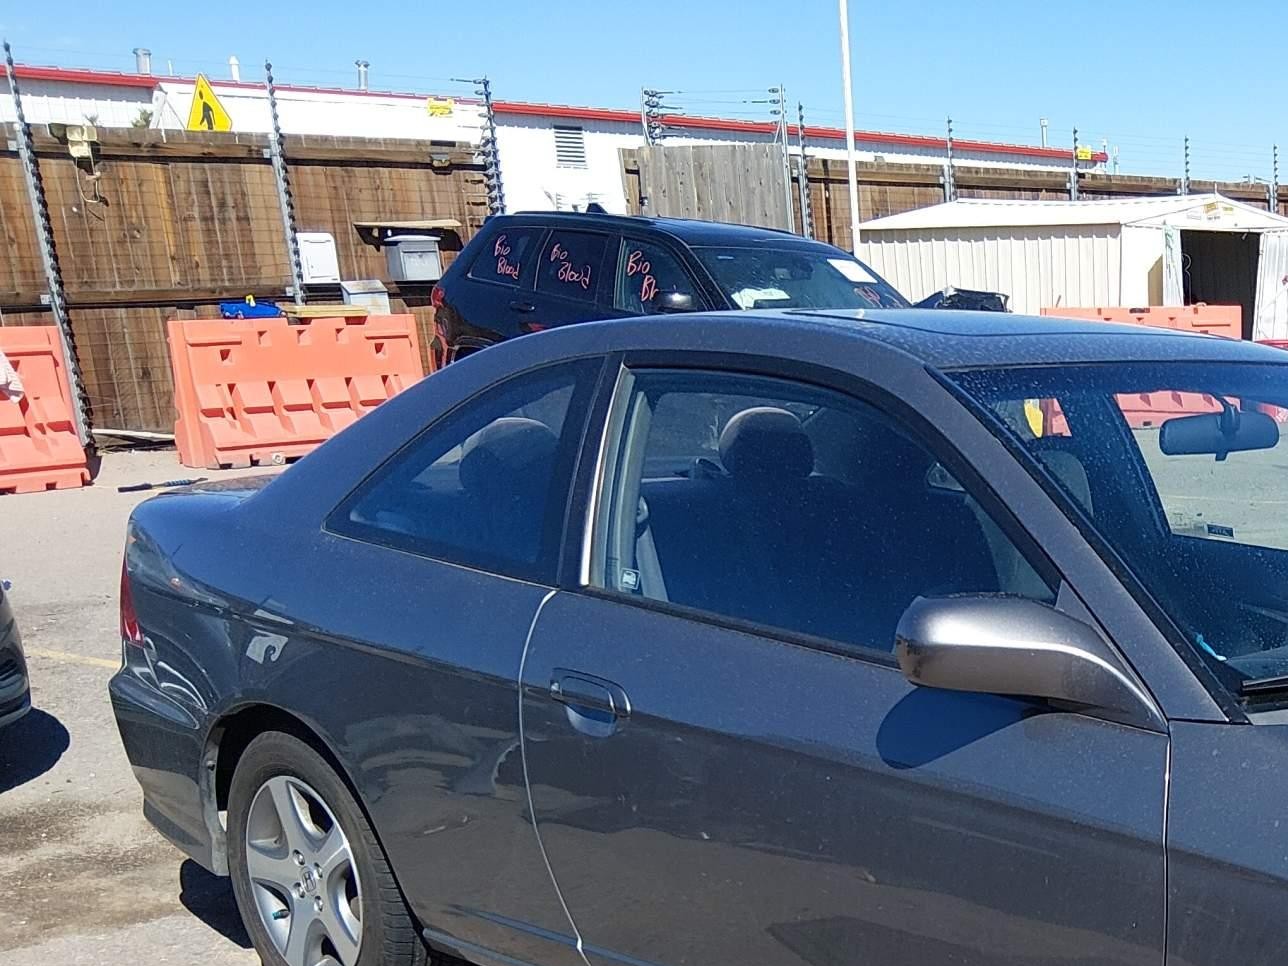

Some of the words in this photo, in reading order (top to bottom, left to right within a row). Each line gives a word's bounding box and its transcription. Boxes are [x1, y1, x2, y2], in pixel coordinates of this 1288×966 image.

[494, 234, 511, 257] Bio
[550, 243, 569, 262] Bio
[497, 256, 520, 280] Blood
[627, 250, 651, 276] Bio
[558, 261, 591, 290] Blood
